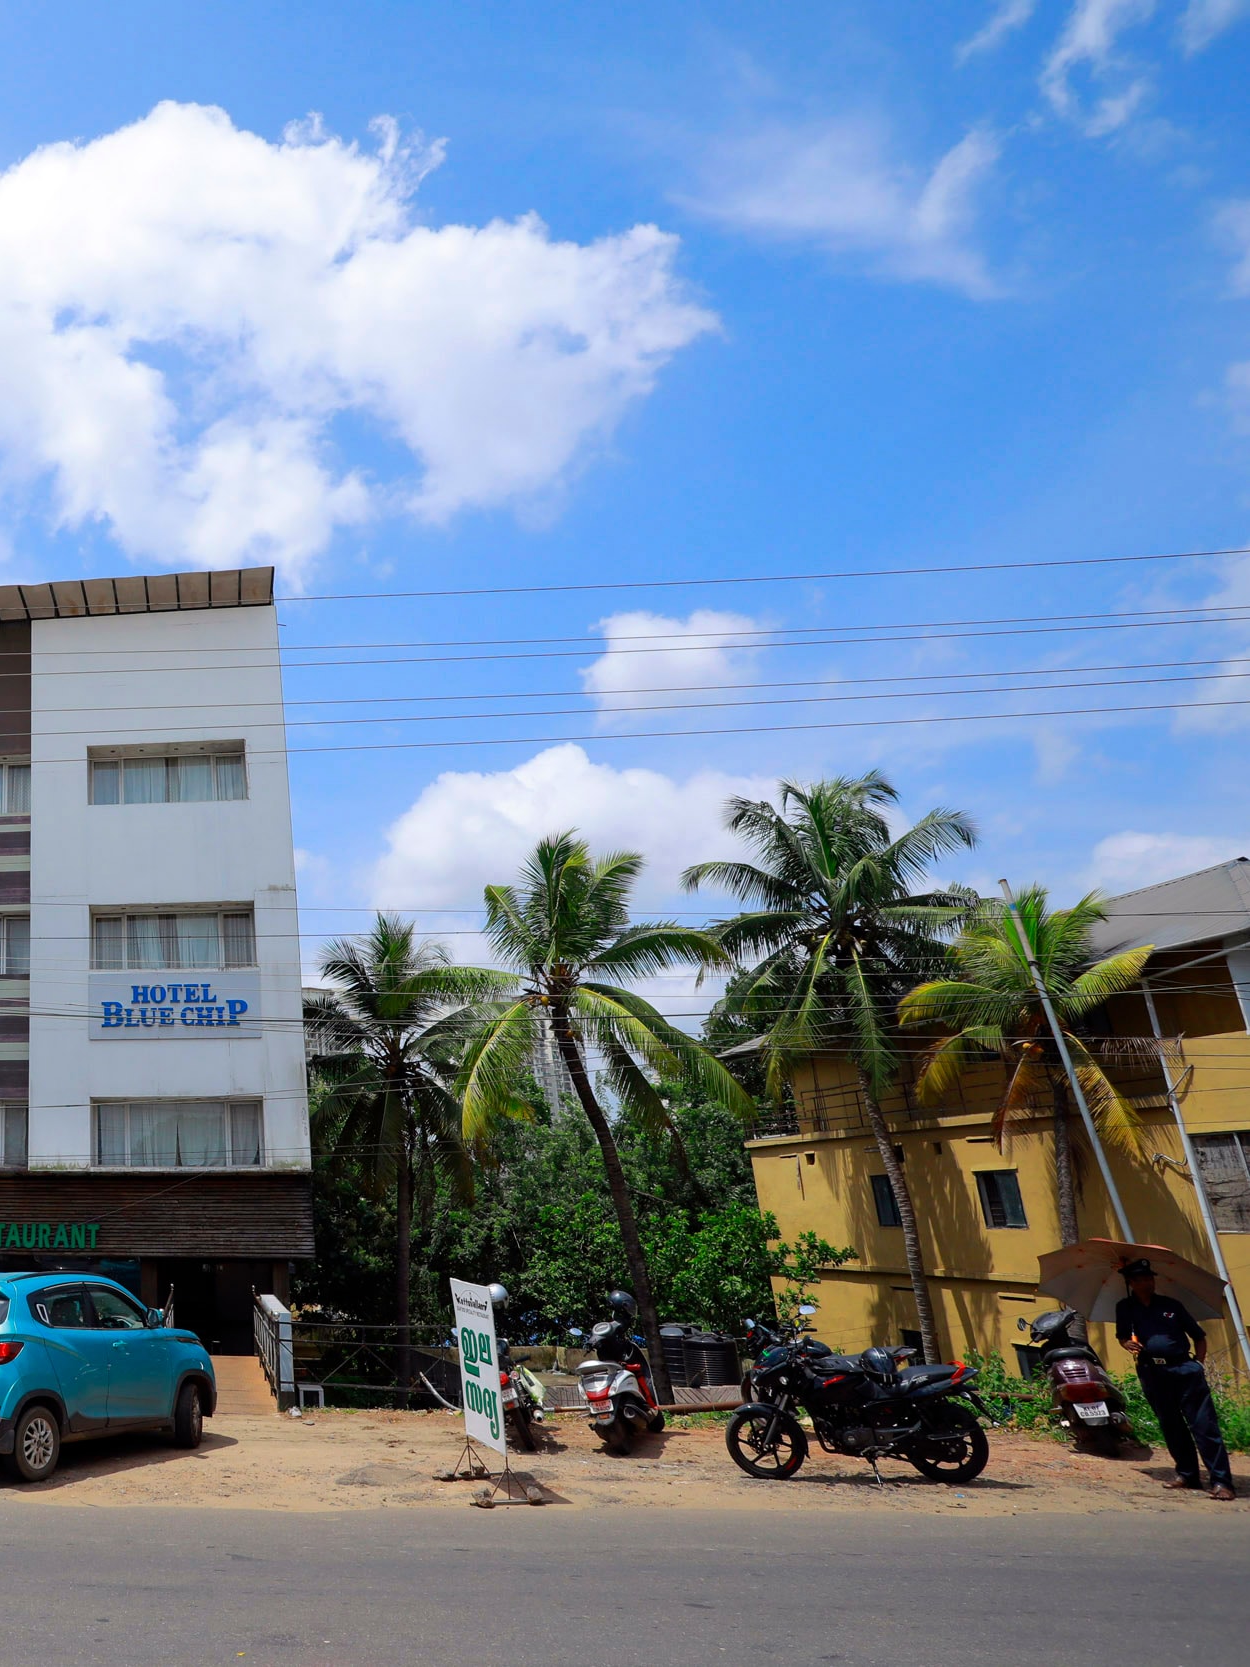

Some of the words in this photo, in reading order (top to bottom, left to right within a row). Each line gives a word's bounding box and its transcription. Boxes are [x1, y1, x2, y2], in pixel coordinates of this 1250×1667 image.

[131, 984, 217, 1004] HOTEL
[101, 1001, 175, 1027] BLUE
[180, 999, 248, 1026] CHIP
